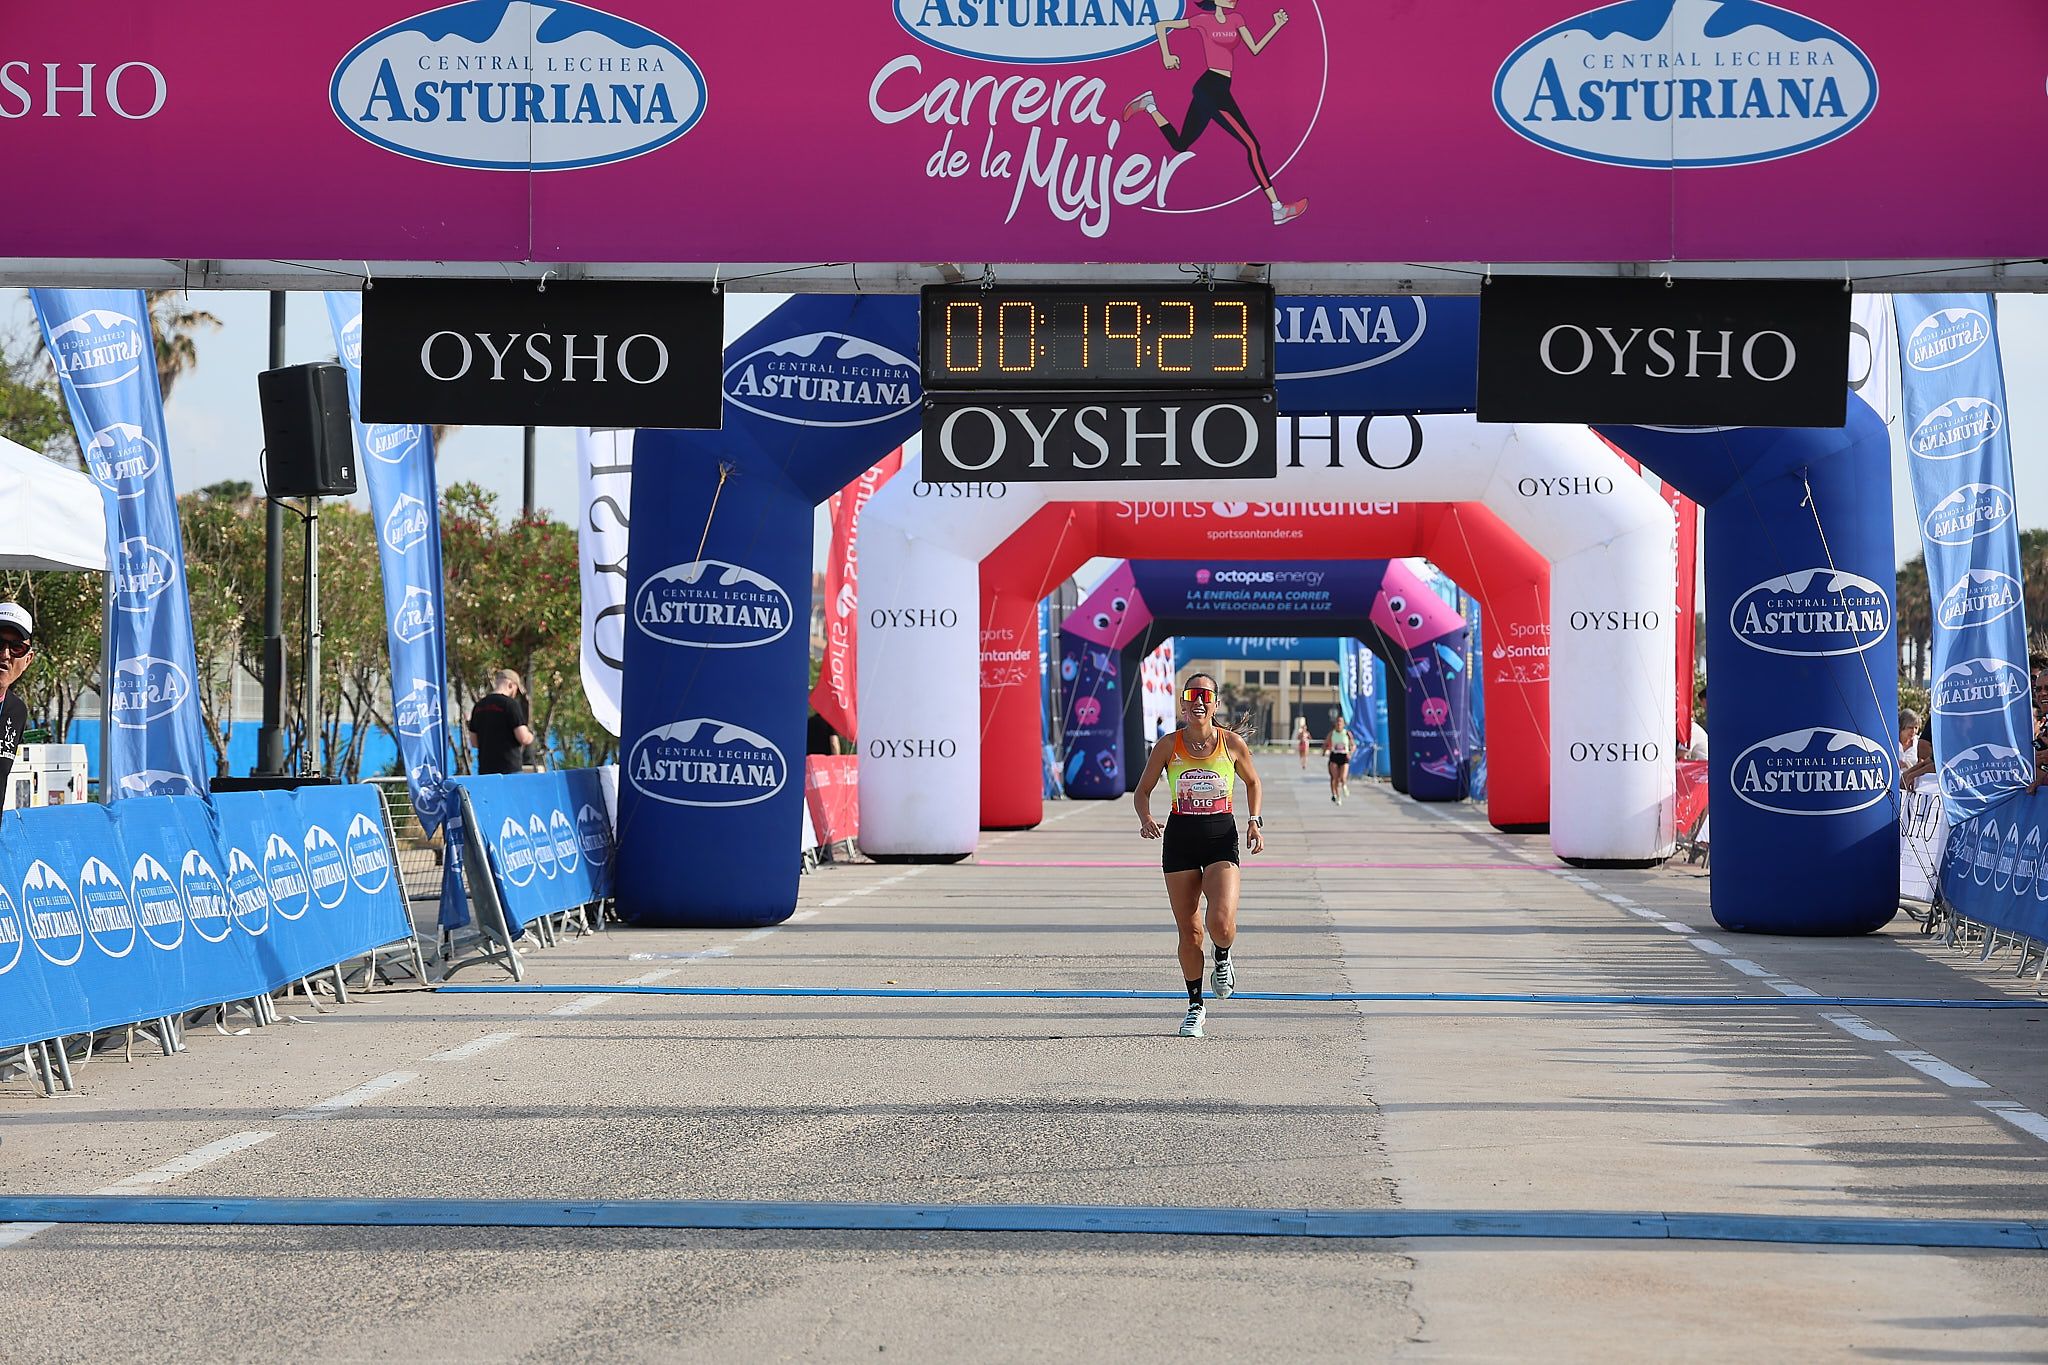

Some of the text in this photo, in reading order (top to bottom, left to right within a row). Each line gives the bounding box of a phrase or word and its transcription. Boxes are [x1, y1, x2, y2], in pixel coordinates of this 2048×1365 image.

[418, 55, 666, 73] CENTRAL LECHERA
[1582, 51, 1835, 69] CENTRAL LECHERA
[359, 57, 678, 125] ASTURIANA
[868, 54, 1107, 126] Carrera
[1523, 57, 1848, 121] ASTURIANA
[925, 119, 1197, 238] de la Mujer
[946, 302, 1248, 371] 00:19:23
[420, 330, 669, 384] OYSHO
[1539, 324, 1797, 382] OYSHO
[768, 361, 910, 379] CENTRAL LECHERA
[731, 364, 912, 405] ASTURIANA
[939, 403, 1259, 471] OYSHO
[913, 480, 1007, 499] OYSHO
[1518, 475, 1614, 497] OYSHO
[1207, 528, 1303, 540] sportssantander.es
[662, 588, 780, 604] CENTRAL LECHERA
[1187, 588, 1330, 600] LA ENERGÍA PARA CORRER
[1767, 598, 1827, 608] CENTRAL
[641, 590, 783, 630] ASTURIANA
[1196, 602, 1210, 610] LA
[1213, 602, 1275, 611] VELOCIDAD
[1277, 602, 1292, 610] DE
[1294, 602, 1309, 610] LA
[1310, 602, 1332, 610] LUZ
[870, 608, 957, 629] OYSHO
[1570, 610, 1659, 631] OYSHO
[1741, 601, 1885, 635] ASTURIANA
[980, 628, 1014, 641] ports
[979, 648, 1031, 662] antander
[657, 746, 773, 761] CENTRAL LECHERA
[869, 738, 956, 759] OYSHO
[1570, 741, 1659, 763] OYSHO
[635, 748, 777, 787] ASTURIANA
[1766, 755, 1882, 767] CENTRAL LECHERA
[1741, 759, 1885, 793] ASTURIANA
[1193, 799, 1213, 807] 016
[28, 900, 82, 940] ASTURIANA
[84, 894, 133, 933] ASTURIANA
